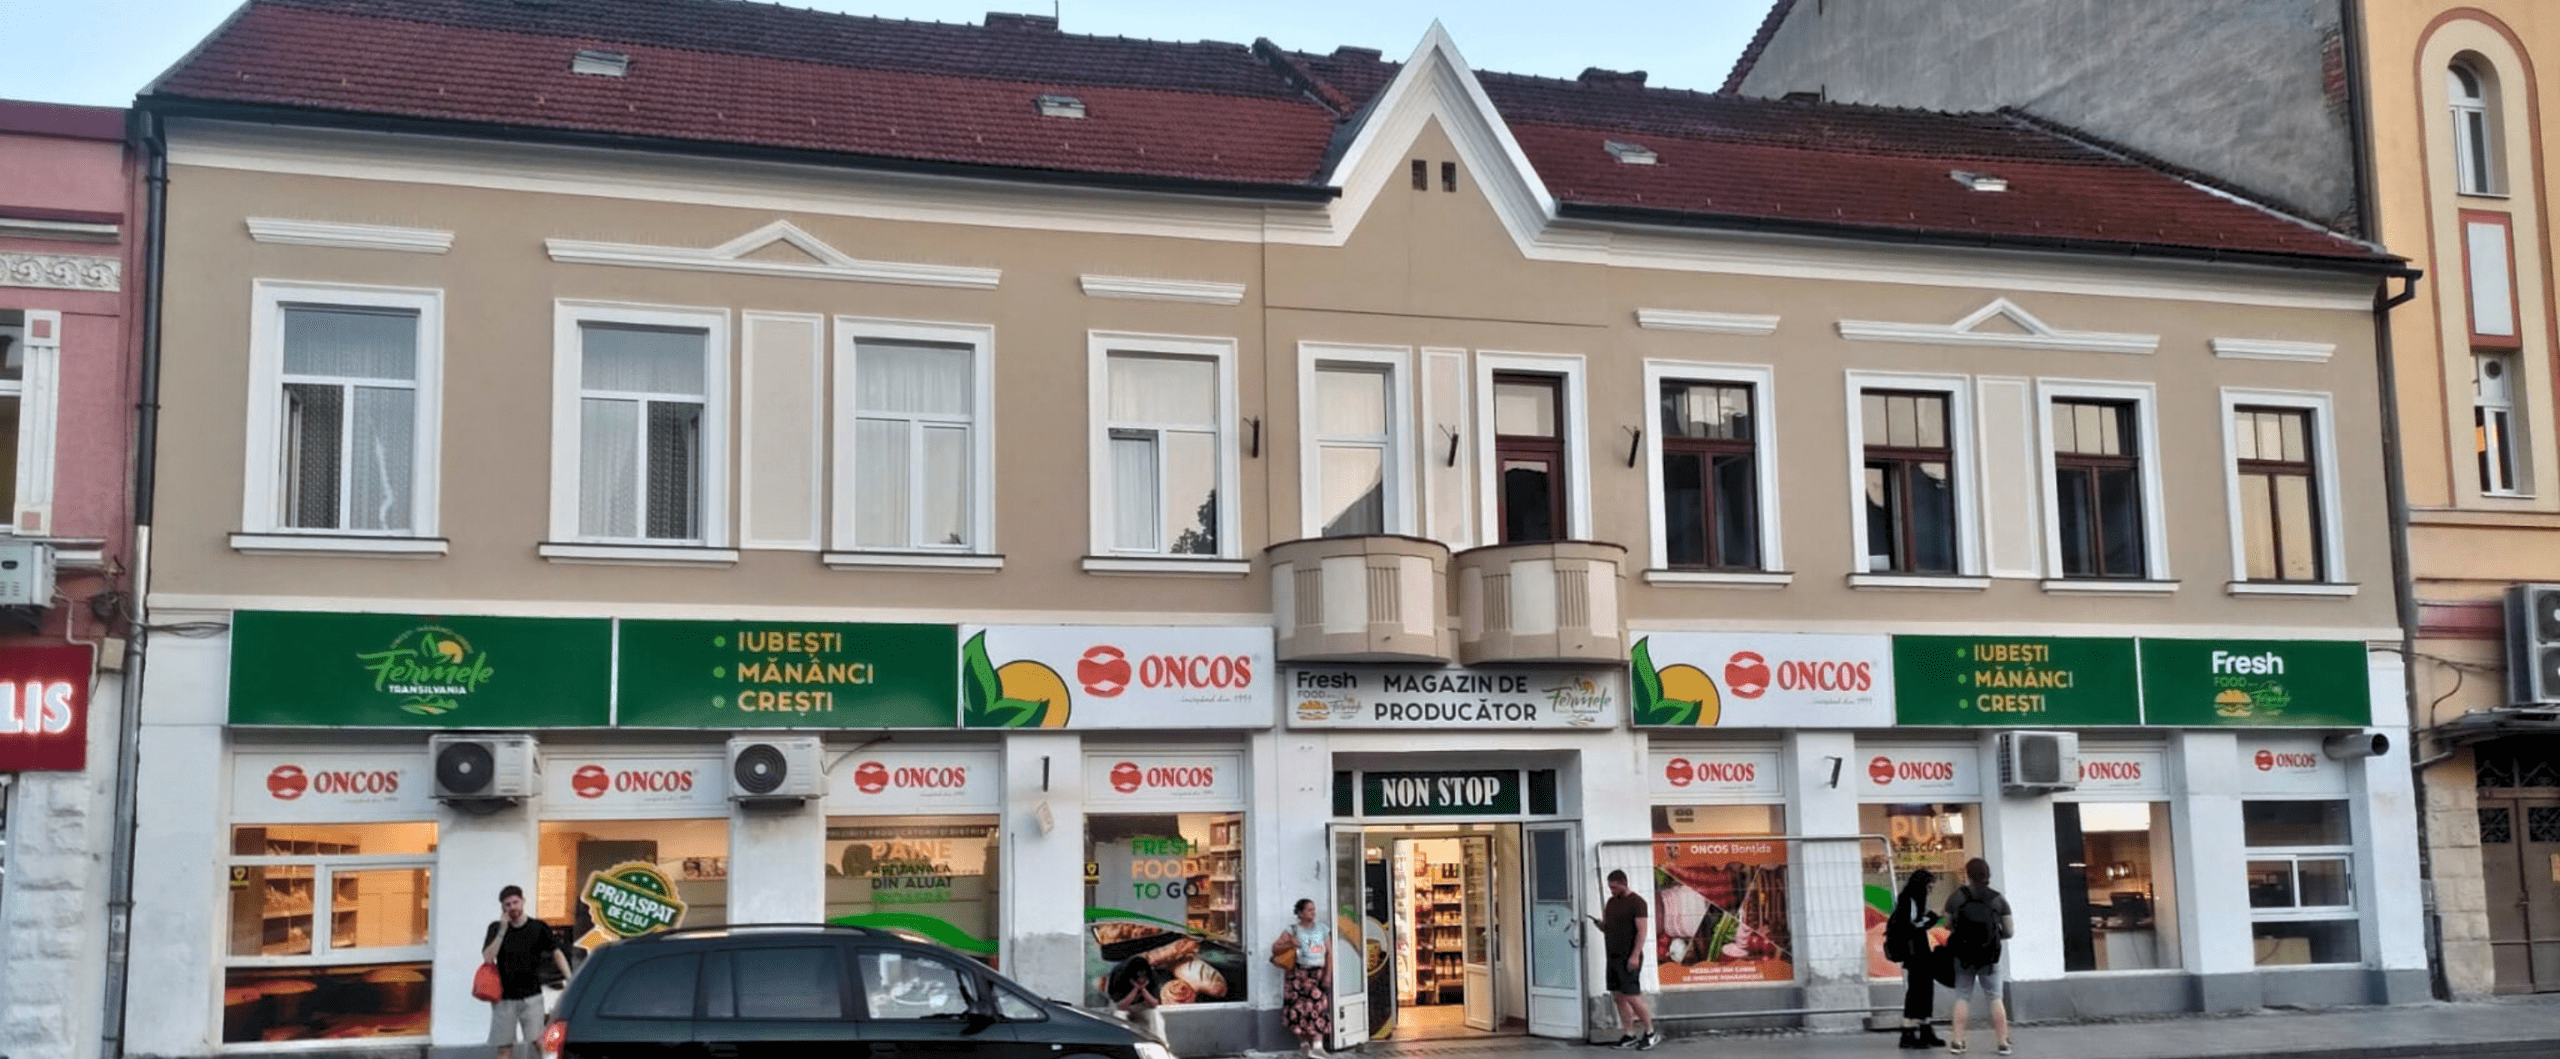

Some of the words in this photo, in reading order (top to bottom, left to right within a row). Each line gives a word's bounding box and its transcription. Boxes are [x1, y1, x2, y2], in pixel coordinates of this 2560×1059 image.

[738, 631, 842, 658] IUBEȘTI
[1974, 644, 2049, 666] IUBEȘTI
[356, 651, 495, 692] Fermele
[738, 656, 874, 684] MĂNÂNCI
[1138, 654, 1252, 689] ONCOS
[2212, 650, 2284, 675] Fresh
[1297, 671, 1358, 689] Fresh
[1384, 674, 1493, 693] MAGAZIN
[1499, 675, 1528, 693] DE
[1777, 660, 1872, 692] ONCOS
[1975, 665, 2074, 688] MĂNÂNCI
[2214, 676, 2248, 688] FOOD
[388, 684, 467, 694] TRANSILVANIA
[1297, 690, 1327, 699] FOOD
[737, 690, 834, 717] CREȘTI
[1374, 698, 1537, 722] PRODUCĂTOR
[1977, 693, 2047, 717] CREȘTI
[1898, 761, 1953, 780] ONCOS
[2088, 761, 2141, 780] ONCOS
[2276, 753, 2317, 768] ONCOS
[314, 770, 399, 794] ONCOS
[614, 770, 693, 793] ONCOS
[894, 767, 966, 788] ONCOS
[1146, 767, 1214, 788] ONCOS
[1697, 762, 1755, 782] ONCOS
[1382, 777, 1430, 808] NON
[1438, 776, 1501, 807] STOP
[1131, 838, 1199, 856] FRESH
[1690, 844, 1729, 855] ONCOS
[1131, 859, 1200, 879] FOOD
[871, 877, 899, 890] DIN
[905, 876, 952, 889] ALUAT
[1132, 882, 1161, 900] TO
[1166, 881, 1200, 899] GO
[608, 904, 623, 919] DE
[623, 911, 649, 927] CLUJ
